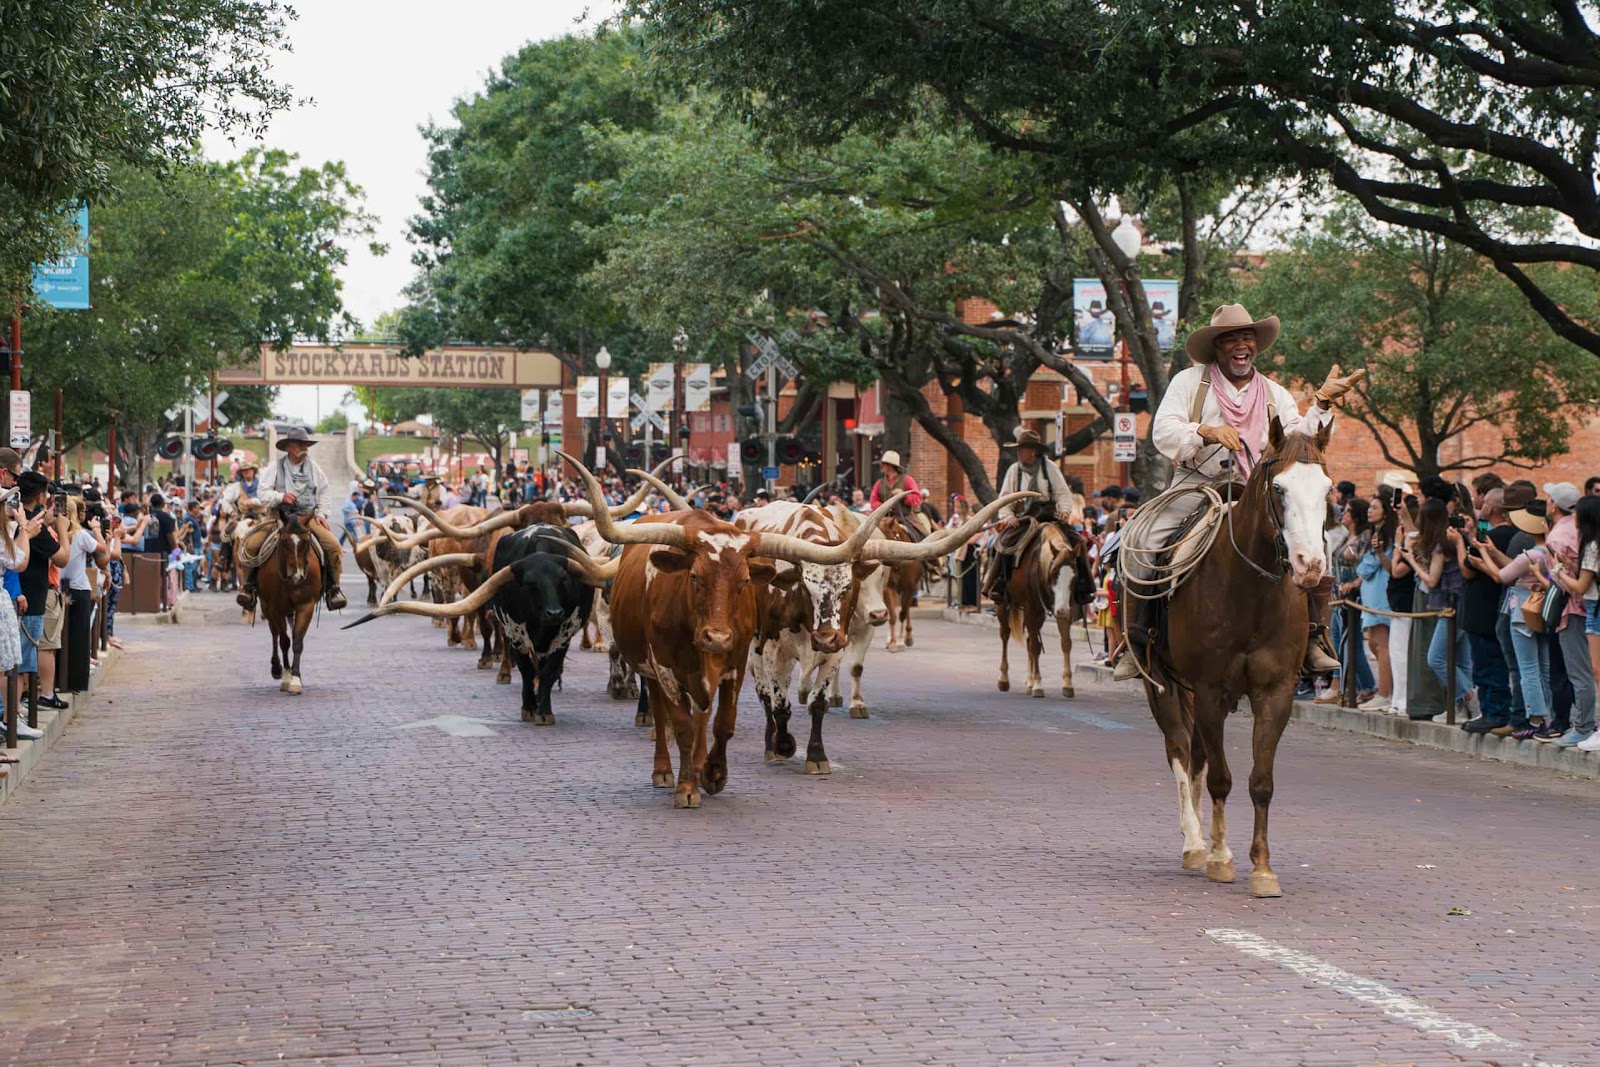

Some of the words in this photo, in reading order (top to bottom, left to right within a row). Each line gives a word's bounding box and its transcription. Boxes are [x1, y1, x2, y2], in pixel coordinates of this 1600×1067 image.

[275, 353, 410, 377] STOCKYARDS
[418, 354, 505, 379] STATION
[775, 357, 796, 378] ROAD
